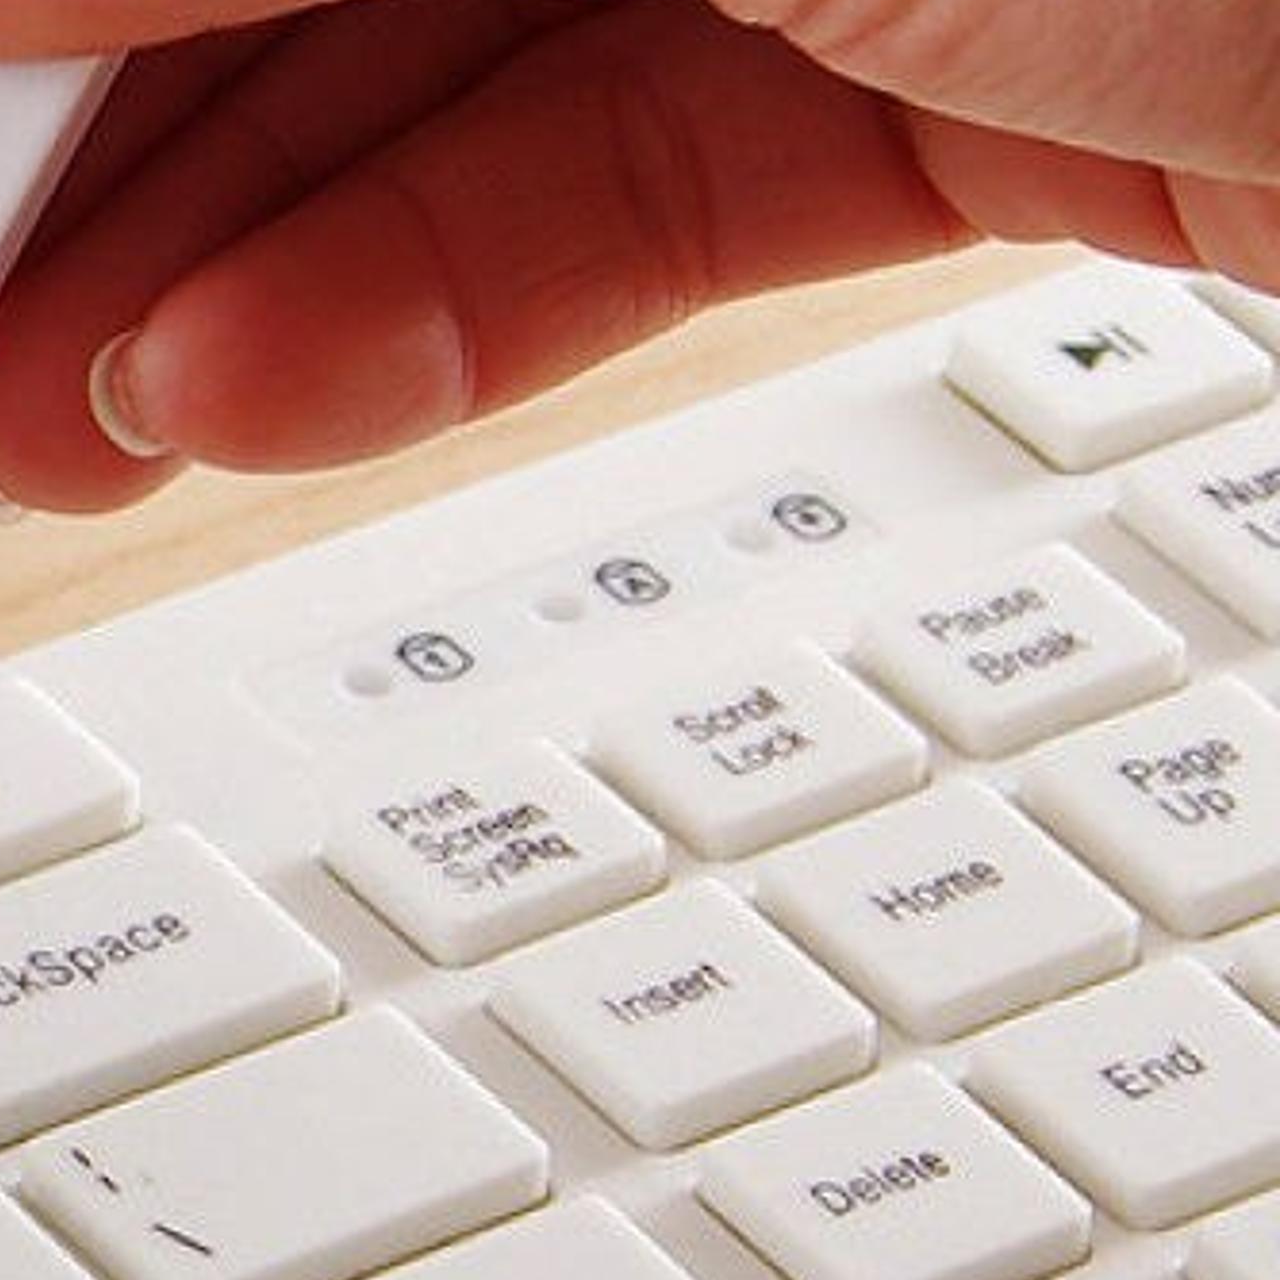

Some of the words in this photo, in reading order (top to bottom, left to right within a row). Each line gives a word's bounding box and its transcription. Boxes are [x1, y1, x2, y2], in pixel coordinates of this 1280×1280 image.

[917, 588, 1049, 644] Pause
[967, 629, 1086, 687] Break
[672, 686, 785, 744] Scroll
[711, 724, 814, 777] Lock
[1117, 739, 1242, 795] Page
[376, 787, 480, 835] Print
[410, 803, 549, 864] Screen
[1156, 788, 1236, 826] Up
[869, 861, 1004, 922] Home
[602, 962, 731, 1025] Insert
[1098, 1042, 1208, 1101] End
[809, 1151, 951, 1218] Delete
